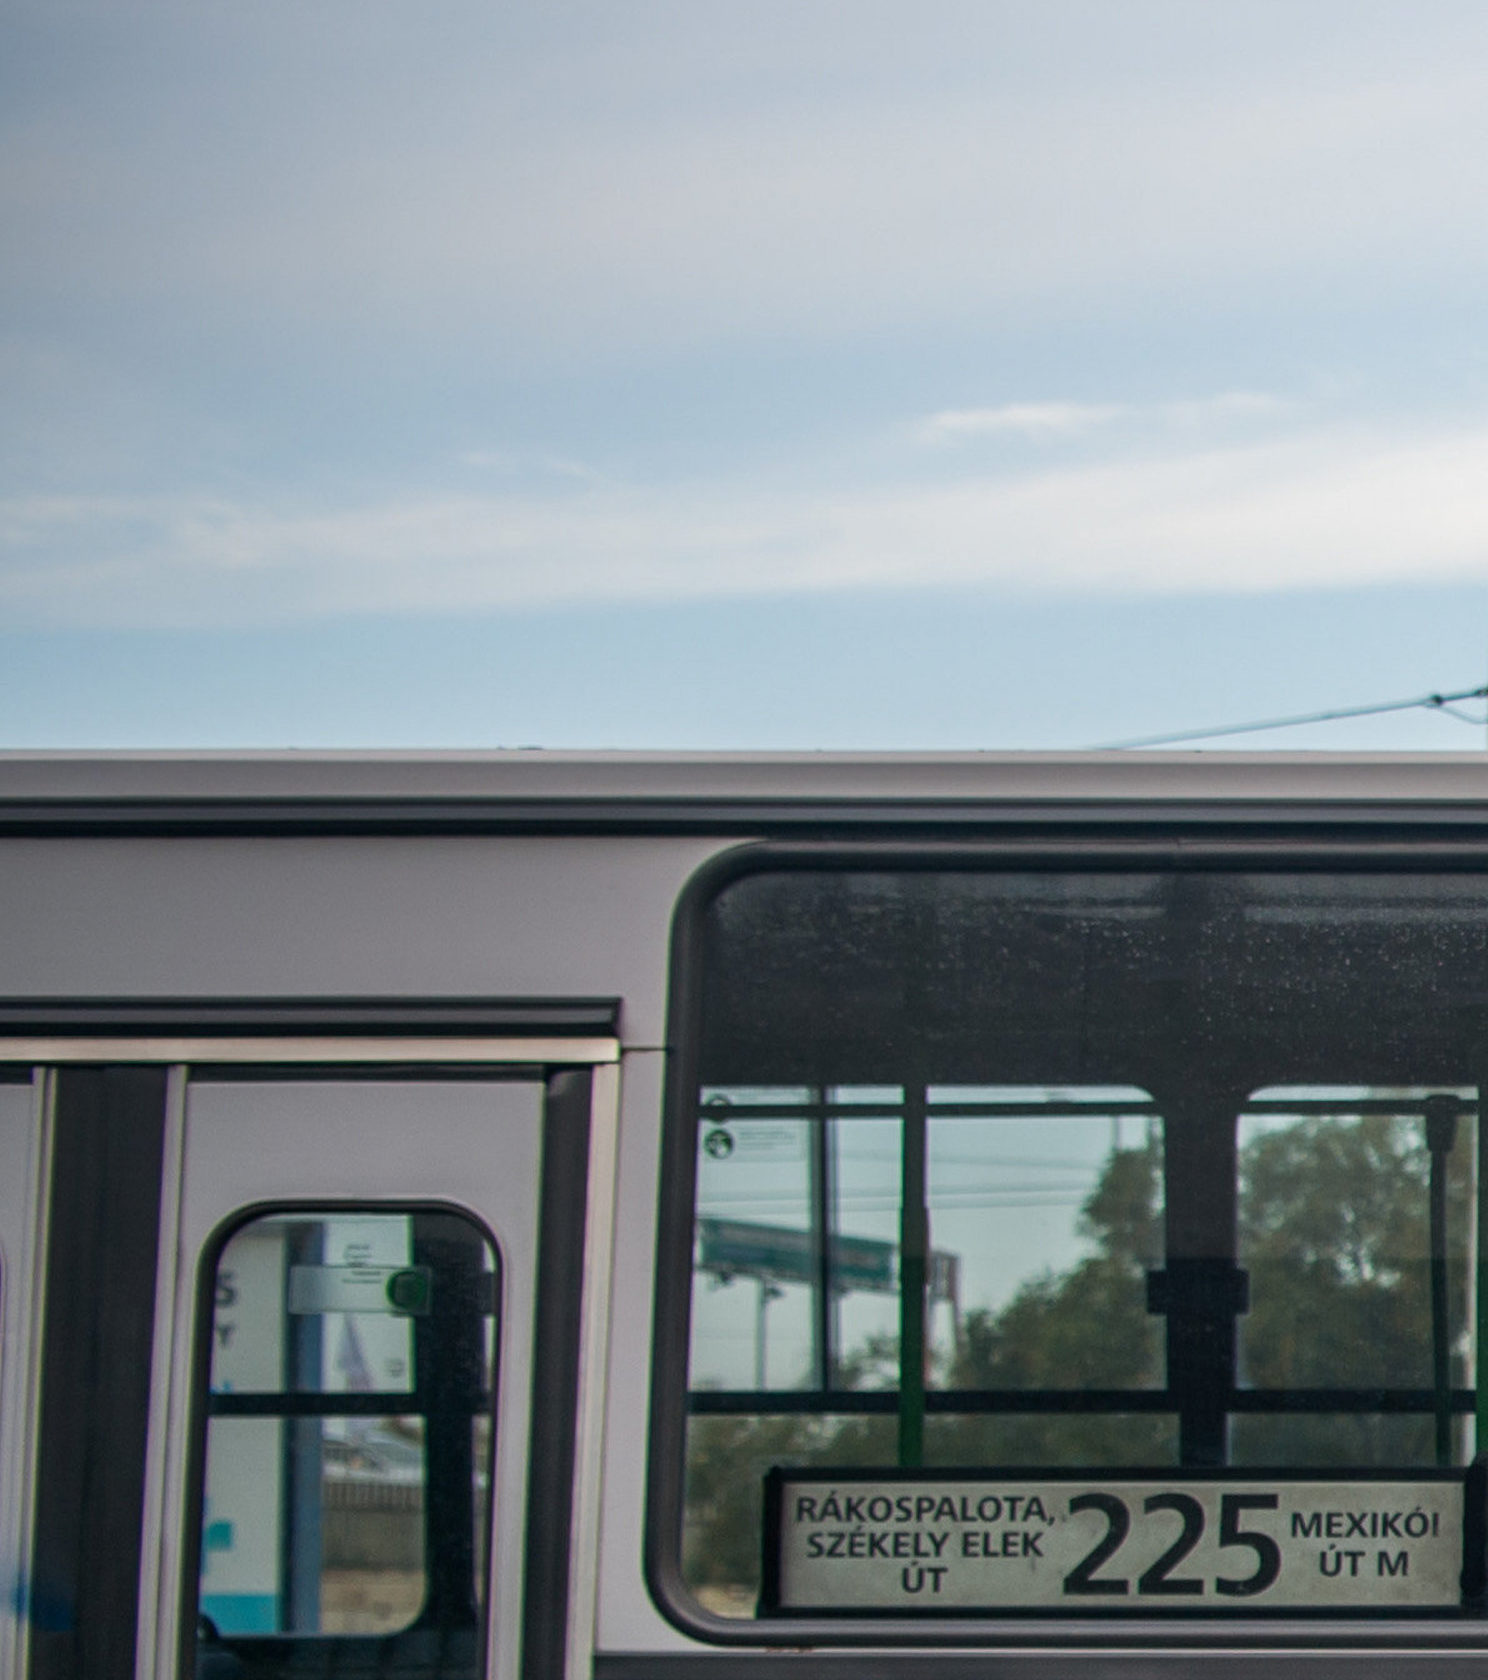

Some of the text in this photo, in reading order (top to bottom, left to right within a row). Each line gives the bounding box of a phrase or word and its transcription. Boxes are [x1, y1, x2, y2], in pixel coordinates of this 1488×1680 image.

[797, 1490, 1055, 1526] RÁKOSPALOTA,
[1291, 1505, 1440, 1539] MEXIKÓI
[806, 1525, 1044, 1558] SZÉKELY ELEK
[1063, 1493, 1282, 1597] 225
[901, 1561, 948, 1593] ÚT
[1319, 1544, 1409, 1577] ÚT M
